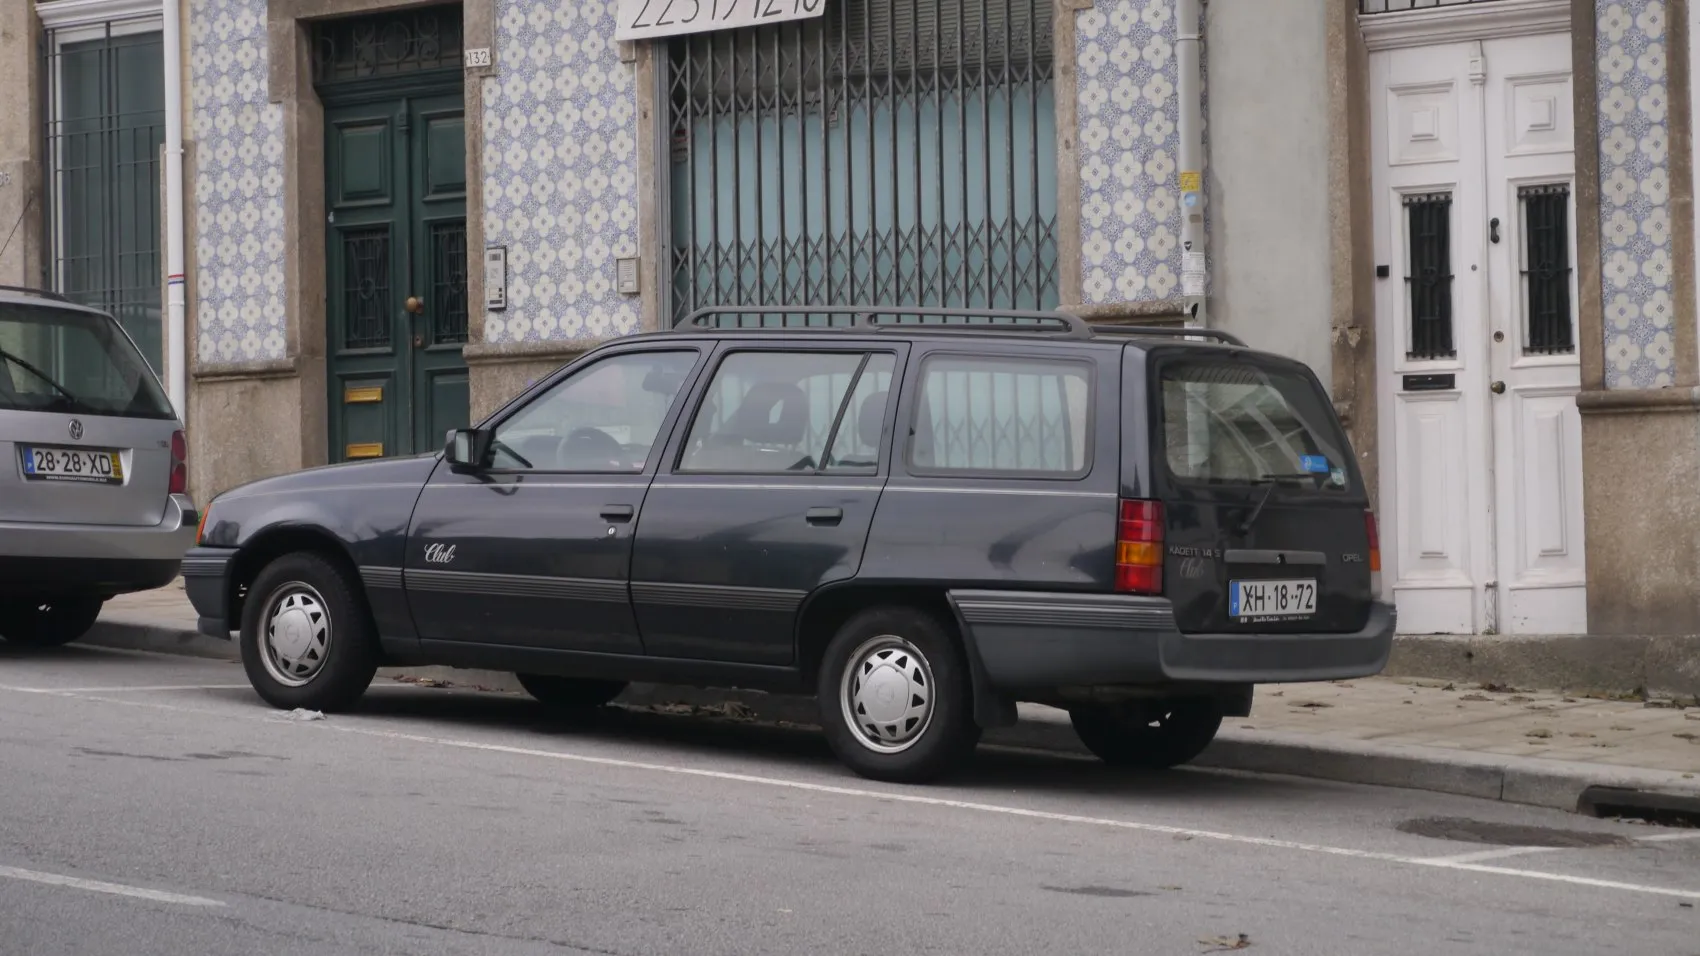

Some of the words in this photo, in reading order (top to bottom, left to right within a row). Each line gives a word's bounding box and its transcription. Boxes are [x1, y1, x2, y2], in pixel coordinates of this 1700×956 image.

[468, 50, 487, 65] 132
[423, 543, 456, 563] Club
[1342, 553, 1364, 562] OPEL
